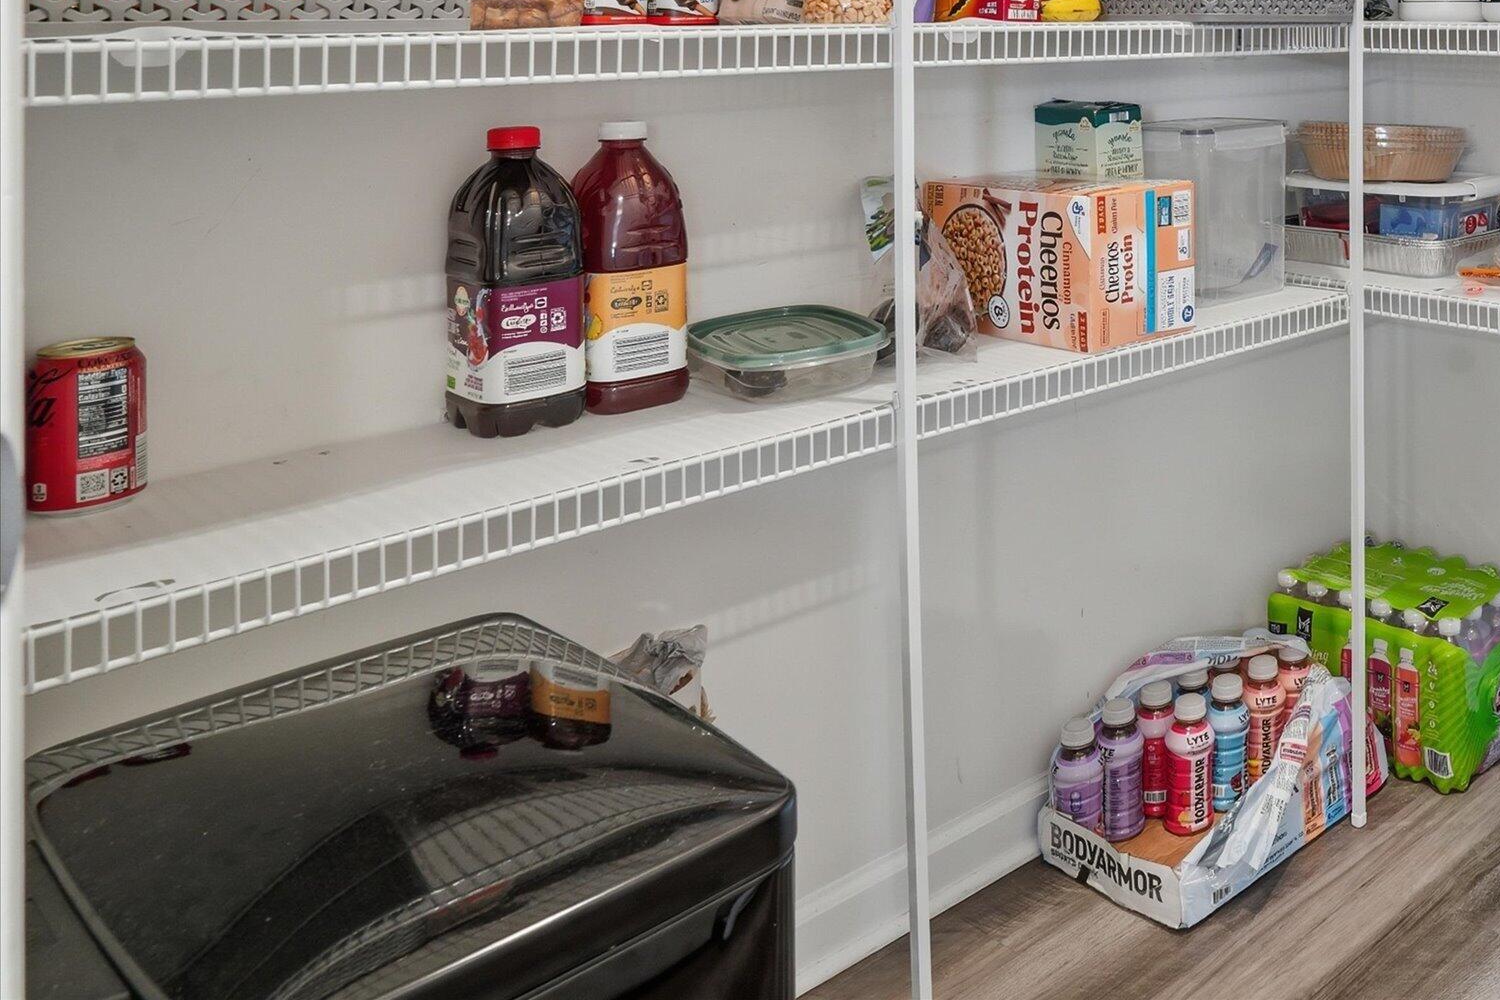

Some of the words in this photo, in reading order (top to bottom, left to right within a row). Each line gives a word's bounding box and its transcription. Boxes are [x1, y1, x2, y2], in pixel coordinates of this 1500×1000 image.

[1017, 201, 1041, 335] Protein
[1039, 211, 1064, 331] Cheerios
[1062, 241, 1073, 305] Cinnamon
[1105, 241, 1119, 303] Cheerios
[1120, 234, 1134, 304] Protein
[1255, 695, 1278, 706] LYTE
[1186, 732, 1209, 746] LYTE
[1261, 718, 1272, 775] ODYARMOR
[1194, 757, 1206, 824] BODYARMOR
[1050, 822, 1164, 903] BODYARMOR
